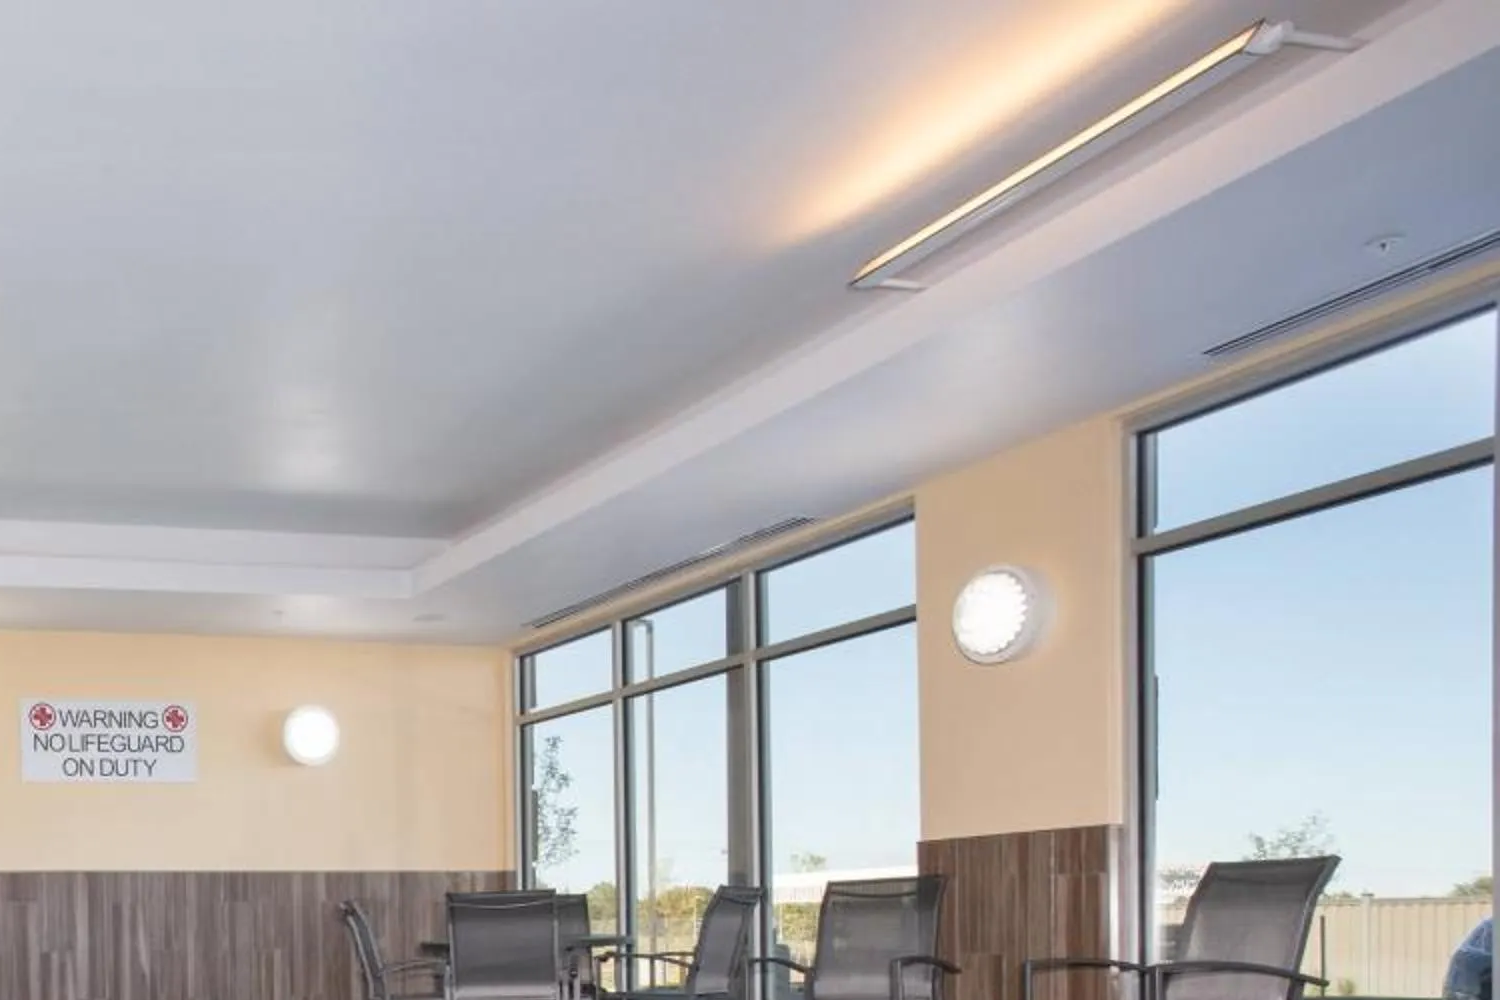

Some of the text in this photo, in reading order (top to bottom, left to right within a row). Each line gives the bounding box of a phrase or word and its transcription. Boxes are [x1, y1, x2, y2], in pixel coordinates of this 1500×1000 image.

[59, 709, 159, 729] WARNING
[33, 733, 185, 753] NO LIFEGUARD
[62, 757, 157, 777] ON DUTY
